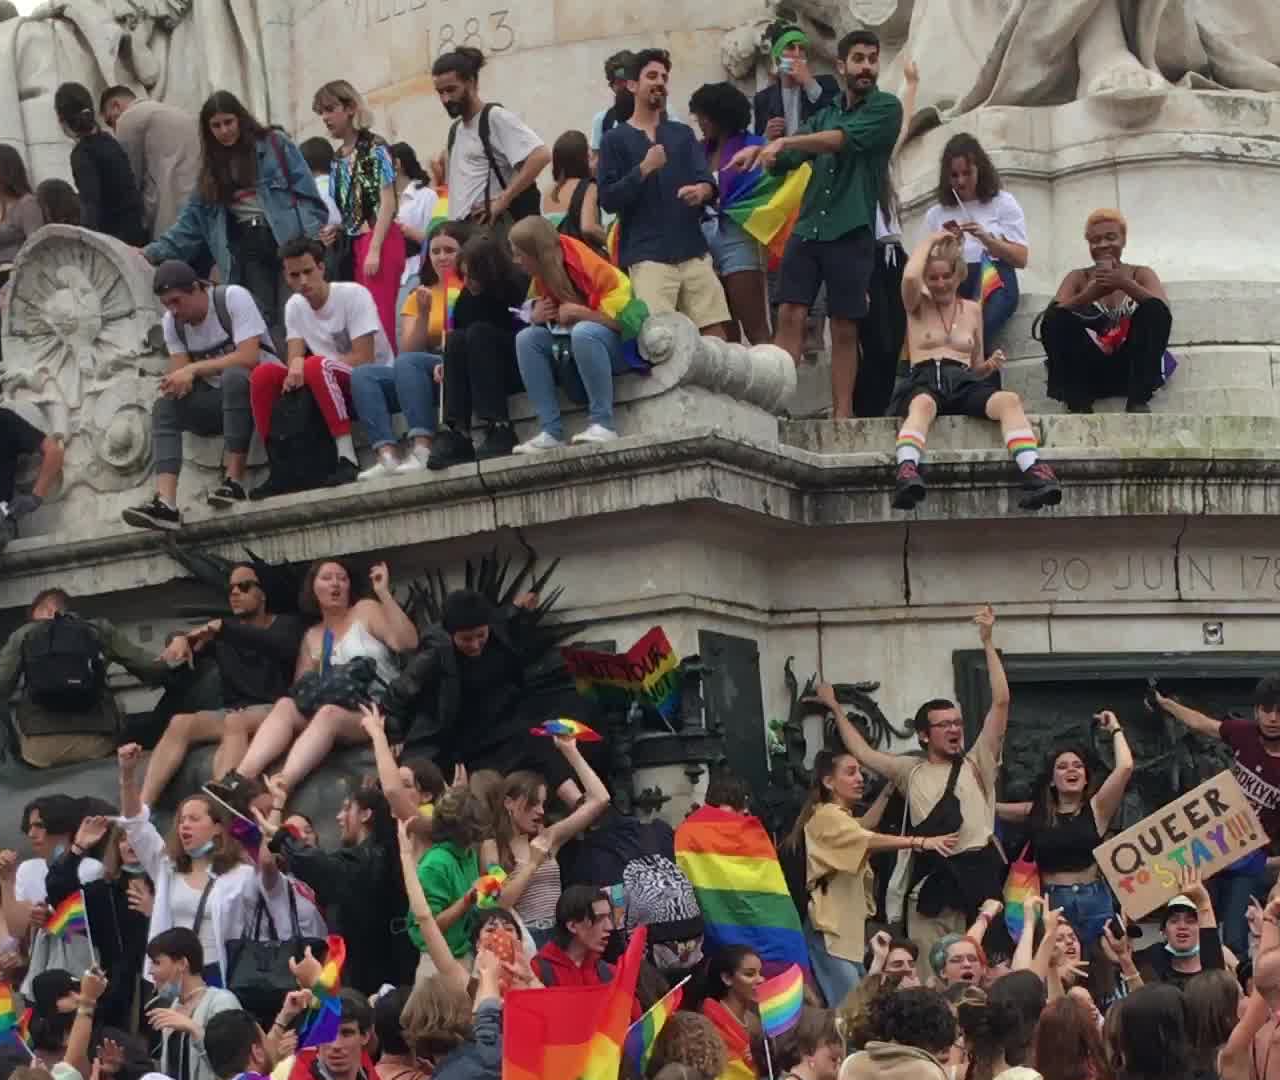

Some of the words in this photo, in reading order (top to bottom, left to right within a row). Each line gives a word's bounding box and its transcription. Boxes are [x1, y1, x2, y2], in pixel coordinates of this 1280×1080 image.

[1040, 556, 1090, 592] 20
[1110, 787, 1232, 874] QUEER
[1117, 868, 1152, 895] TO
